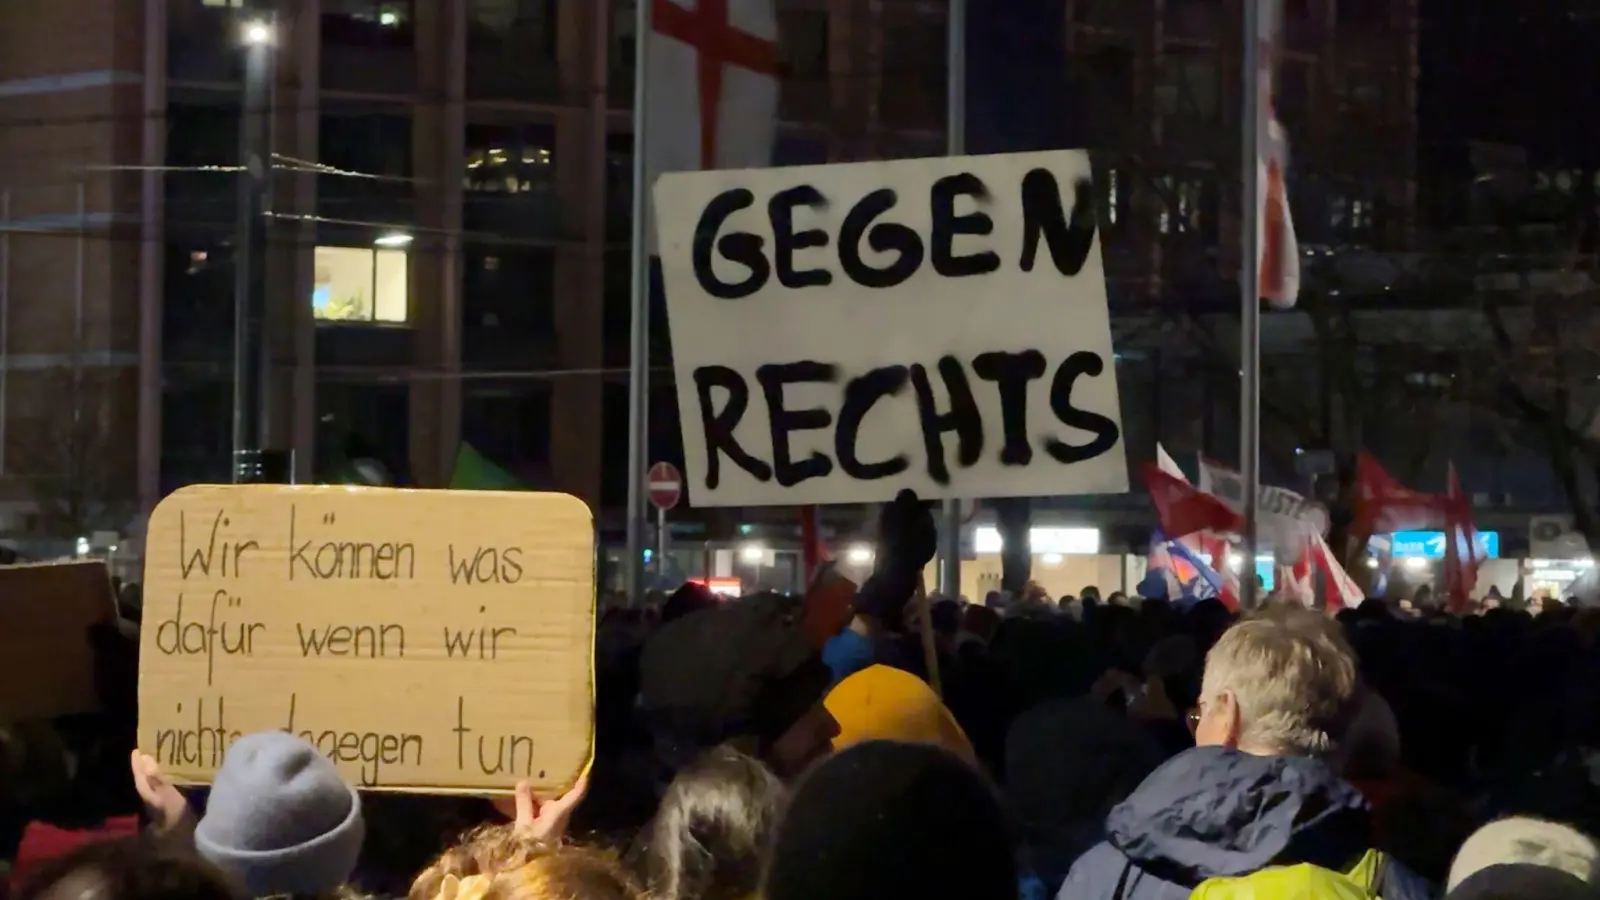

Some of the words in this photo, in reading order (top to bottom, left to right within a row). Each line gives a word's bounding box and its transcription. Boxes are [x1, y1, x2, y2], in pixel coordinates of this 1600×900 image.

[693, 167, 1097, 299] GEGEN
[693, 349, 1120, 490] RECHTS
[180, 508, 259, 580] Wir
[289, 503, 414, 581] können
[448, 542, 523, 585] was
[156, 589, 266, 686] dafür
[296, 621, 405, 659] wenn
[444, 605, 517, 660] wir
[452, 696, 547, 779] tun.
